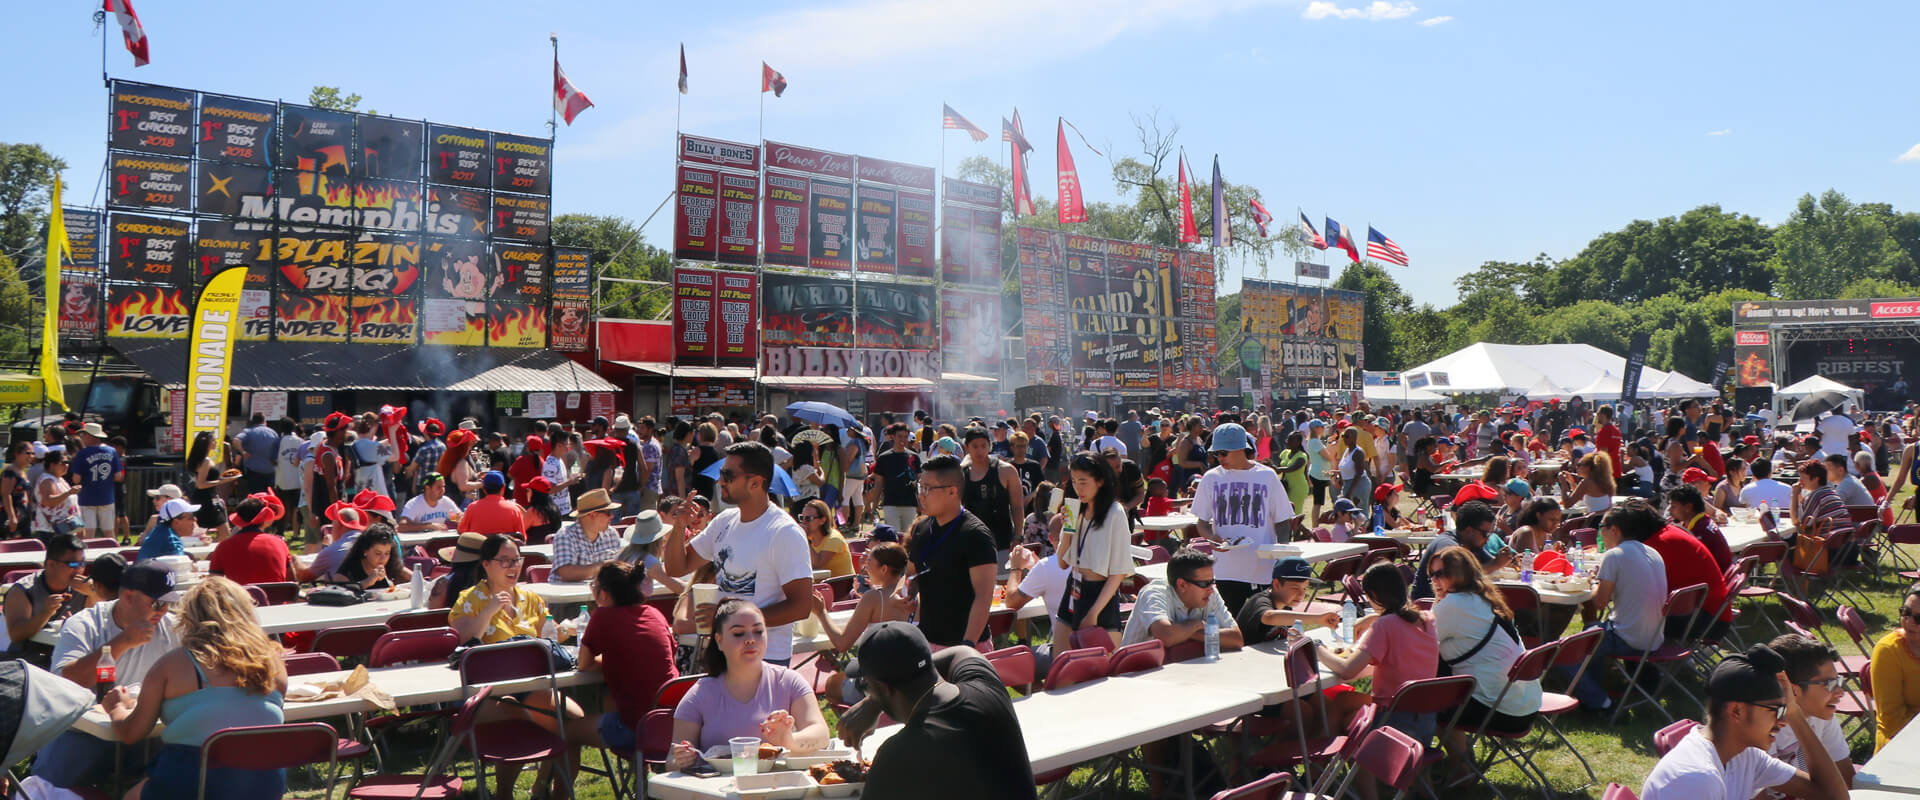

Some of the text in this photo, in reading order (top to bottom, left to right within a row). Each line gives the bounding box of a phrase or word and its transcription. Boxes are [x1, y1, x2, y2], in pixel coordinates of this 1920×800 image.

[149, 111, 177, 123] BEST
[138, 122, 188, 136] CHICKEN
[227, 123, 258, 136] BEST
[146, 136, 176, 147] 2018
[226, 135, 256, 147] RIBS
[436, 134, 486, 148] OTTAWA
[225, 147, 253, 158] 2018
[458, 150, 481, 160] BEST
[686, 139, 753, 161] BILLY BONES
[774, 147, 817, 170] Peace,
[818, 155, 849, 173] Love
[860, 166, 887, 177] and
[150, 172, 175, 182] BEST
[513, 167, 542, 177] SAUCE
[140, 181, 184, 192] CHICKEN
[145, 193, 175, 203] 2013
[685, 206, 712, 217] CHOICE
[727, 211, 752, 221] CHOICE
[234, 195, 462, 241] Memphis
[688, 216, 707, 226] BEST
[730, 220, 748, 230] BEST
[146, 238, 176, 250] BEST
[1069, 237, 1176, 263] ALABAMA'S FINEST
[146, 250, 174, 262] RIBS
[502, 250, 545, 262] CALGARY
[143, 263, 172, 274] 2013
[303, 266, 396, 292] BBQ
[678, 273, 713, 285] MONTREAL
[724, 277, 750, 288] WHITBY
[681, 299, 711, 311] JUDGE'S
[722, 301, 750, 313] JUDGE'S
[774, 285, 929, 322] WORLD FAMOUS
[1072, 292, 1132, 334] CAMP
[1133, 268, 1179, 345] 31
[683, 310, 710, 321] CHOICE
[1875, 305, 1913, 315] ACCESS
[723, 312, 749, 323] CHOICE
[123, 315, 190, 333] LOVE
[687, 321, 705, 331] BEST
[727, 323, 745, 333] BEST
[360, 322, 414, 340] RIBS!
[684, 331, 708, 342] SAUCE
[727, 333, 744, 343] RIBS
[766, 348, 940, 379] BILLY BONES
[1816, 361, 1904, 376] RIBFEST
[89, 462, 112, 481] 19
